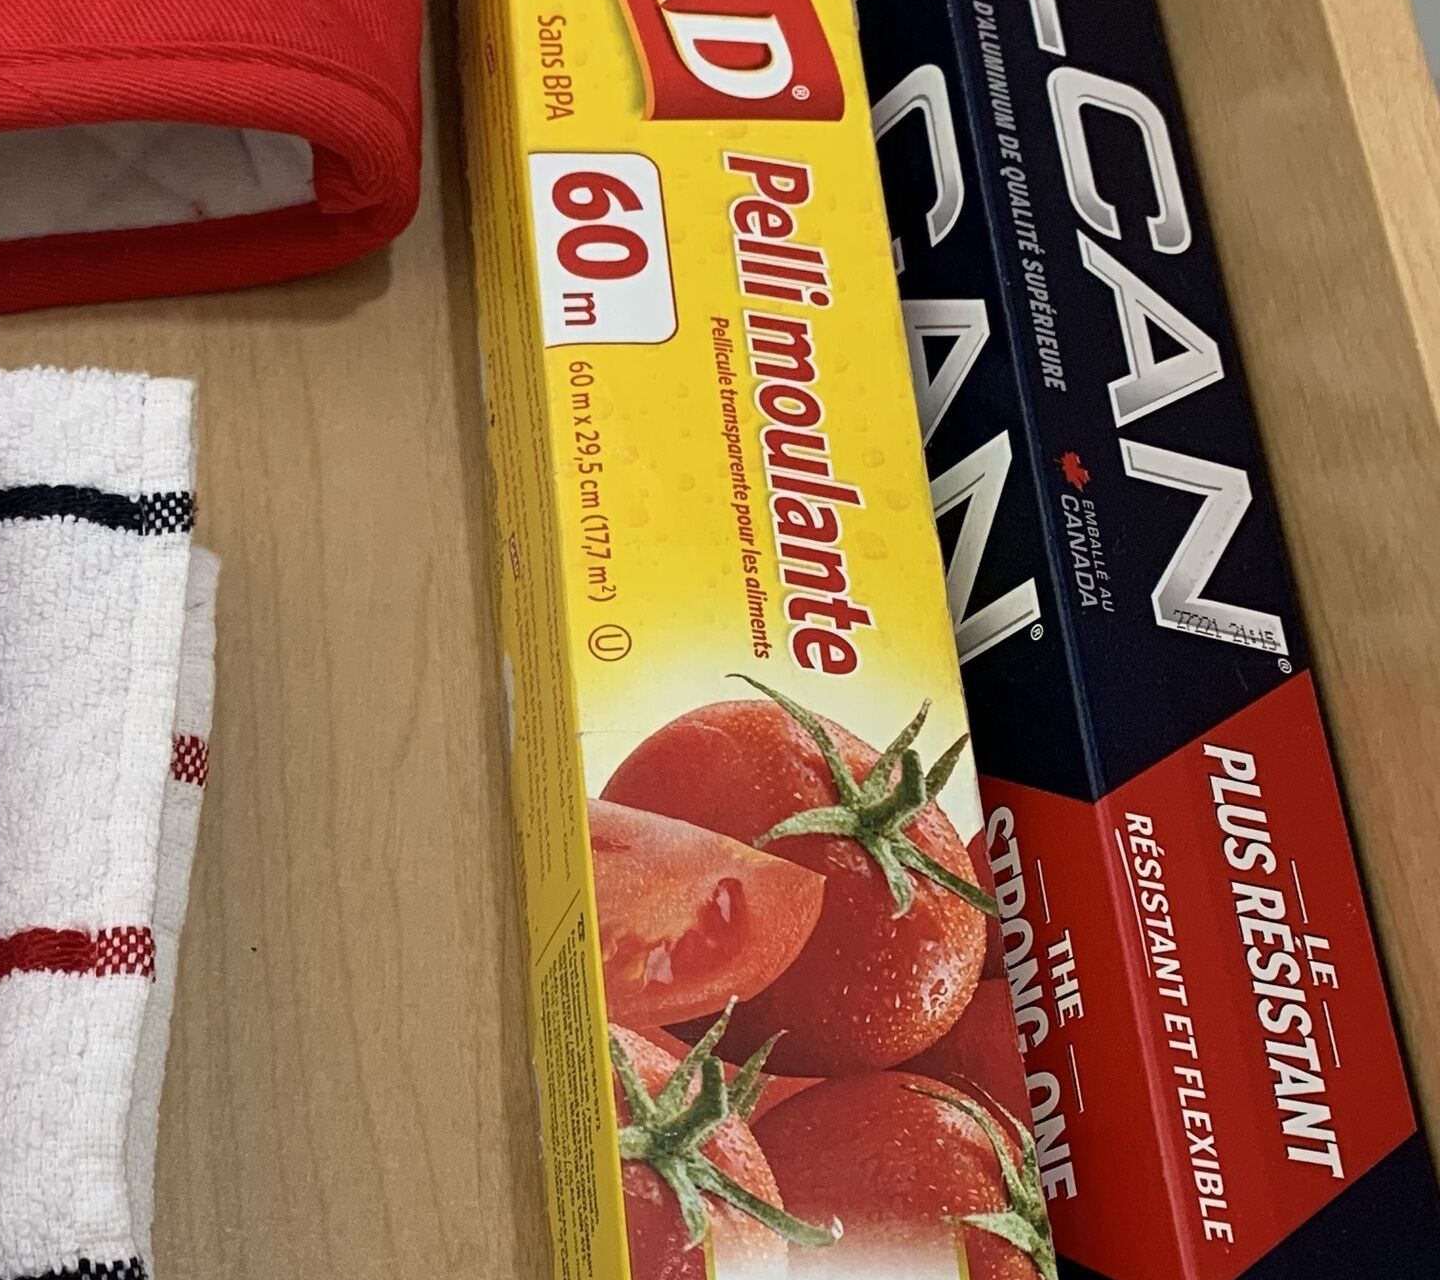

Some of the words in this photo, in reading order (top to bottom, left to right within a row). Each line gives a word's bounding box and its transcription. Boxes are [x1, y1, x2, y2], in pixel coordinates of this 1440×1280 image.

[537, 14, 564, 68] Sans
[973, 3, 1016, 132] D'ALUMINIUM
[543, 74, 574, 121] BPA
[997, 132, 1023, 162] DE
[551, 170, 649, 280] 60
[722, 152, 832, 309] Pelli
[1000, 166, 1034, 254] QUALITÉ
[561, 291, 597, 326] m
[710, 316, 732, 386] Pellicule
[1020, 259, 1067, 392] SUPÉRIEURE
[568, 360, 595, 389] 60
[571, 392, 591, 410] m
[573, 414, 591, 427] x
[573, 431, 603, 475] 29,5
[718, 386, 748, 501] transparente
[580, 479, 601, 508] cm
[731, 502, 756, 548] pour
[744, 311, 877, 676] moulante
[580, 514, 613, 561] (17,7
[739, 549, 757, 574] les
[1060, 494, 1100, 609] CANADA
[1080, 499, 1110, 582] EMBALLÉ
[1098, 585, 1116, 614] AU
[744, 575, 771, 660] aliments
[1202, 743, 1278, 876] PLUS
[1123, 810, 1188, 1007] RÉSISTANT
[1046, 928, 1085, 1028] THE
[1302, 935, 1340, 990] LE
[1163, 1012, 1200, 1061] ET
[1230, 881, 1345, 1180] RÉSISTANT
[1027, 1070, 1079, 1203] ONE
[1173, 1065, 1235, 1245] FLEXIBLE
